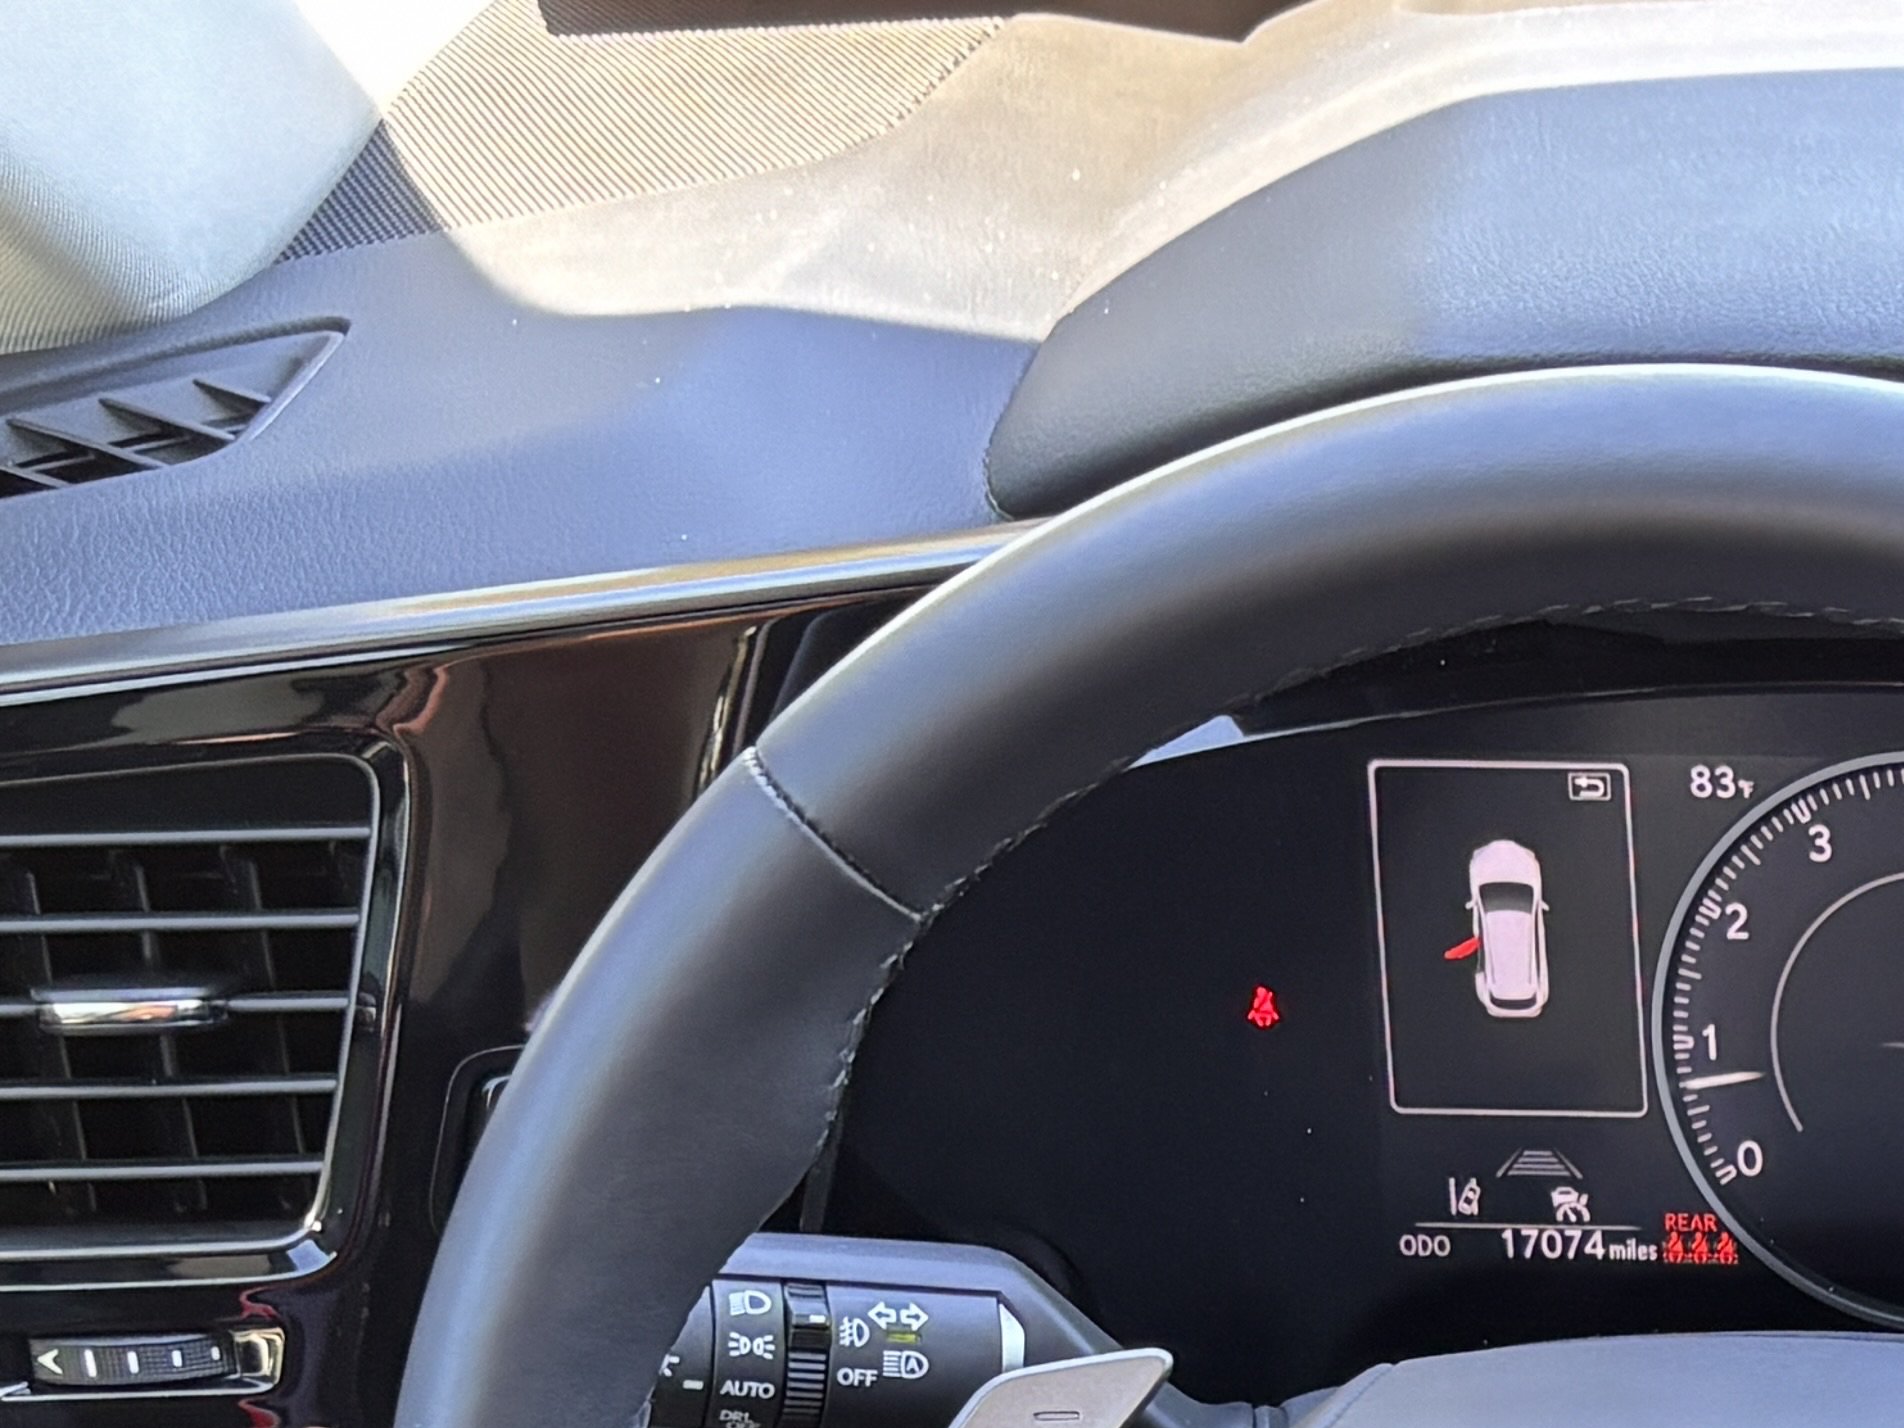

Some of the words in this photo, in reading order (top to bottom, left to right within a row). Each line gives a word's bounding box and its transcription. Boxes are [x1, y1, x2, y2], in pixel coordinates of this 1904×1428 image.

[1809, 825, 1833, 863] 3
[1724, 904, 1750, 941] 2
[1701, 1025, 1719, 1059] 1
[1736, 1141, 1763, 1176] 0
[1664, 1212, 1718, 1233] REAR
[1400, 1234, 1451, 1257] ODO
[1501, 1229, 1606, 1260] 17074
[1609, 1238, 1658, 1262] miles
[719, 1380, 775, 1399] AUTO
[836, 1367, 879, 1387] OFF
